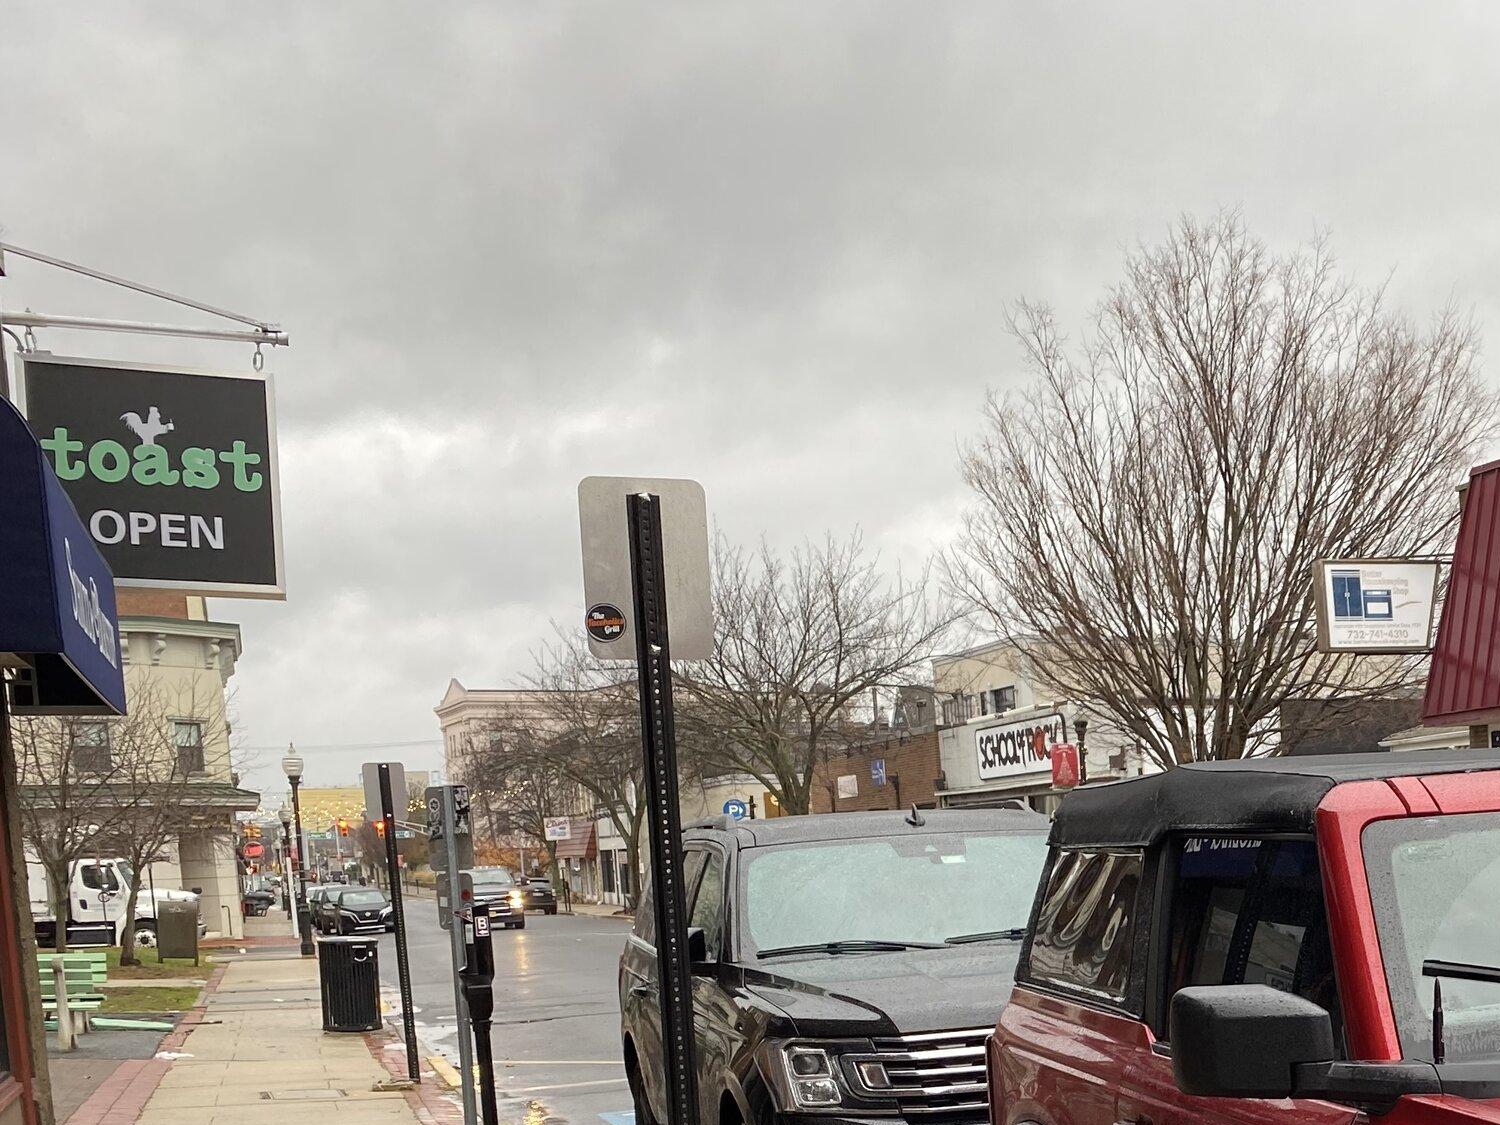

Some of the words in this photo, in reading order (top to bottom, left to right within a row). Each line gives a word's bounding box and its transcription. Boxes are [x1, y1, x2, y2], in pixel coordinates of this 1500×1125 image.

[40, 427, 262, 492] toast
[89, 509, 225, 550] OPEN
[1348, 630, 1408, 639] 732-741-4310
[980, 730, 1019, 769] SCHOOL
[728, 805, 739, 815] P
[478, 917, 486, 930] B
